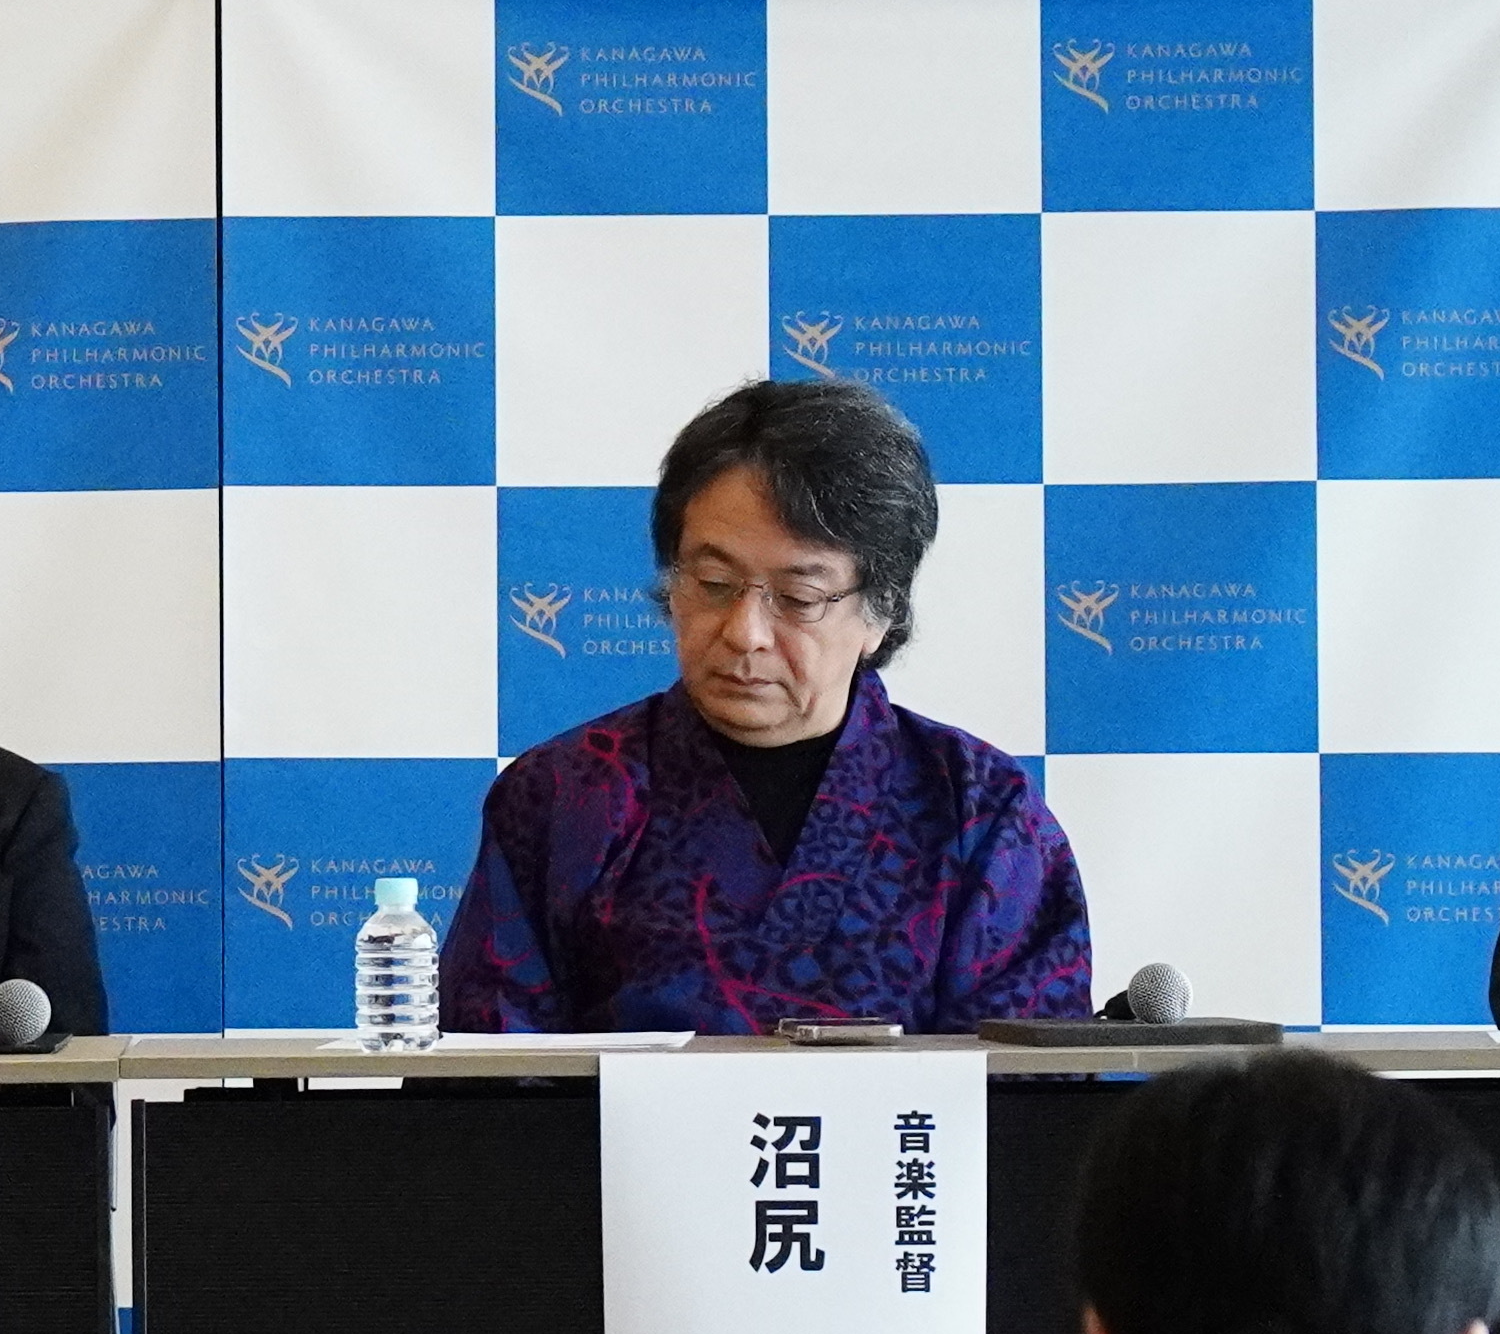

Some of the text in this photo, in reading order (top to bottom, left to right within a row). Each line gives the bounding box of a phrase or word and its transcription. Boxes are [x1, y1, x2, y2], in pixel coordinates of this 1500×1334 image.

[581, 47, 706, 62] KANAGAWA
[1127, 44, 1252, 59] KANAGAWA
[581, 72, 757, 88] PHILHARMONIC
[1127, 68, 1303, 85] PHILHARMONIC
[581, 99, 712, 114] ORCHESTRA
[1127, 96, 1258, 111] ORCHESTRA
[31, 323, 156, 338] KANAGAWA
[310, 318, 435, 333] KANAGAWA
[856, 316, 980, 331] KANAGAWA
[31, 347, 207, 364] PHILHARMONIC
[310, 343, 486, 359] PHILHARMONIC
[856, 341, 1031, 357] PHILHARMONIC
[31, 374, 162, 390] ORCHESTRA
[310, 370, 441, 385] ORCHESTRA
[583, 588, 645, 603] KANA
[1131, 585, 1256, 600] KANAGAWA
[1131, 610, 1307, 626] PHILHARMONIC
[583, 639, 672, 656] ORCHES
[1132, 637, 1264, 652] ORCHESTRA
[82, 864, 159, 879] AGAWA
[311, 858, 436, 874] KANAGAWA
[88, 889, 209, 905] HARMONIC
[99, 916, 167, 932] ESTRA
[749, 1112, 826, 1274] 沼尻
[894, 1110, 937, 1293] 音楽監督
